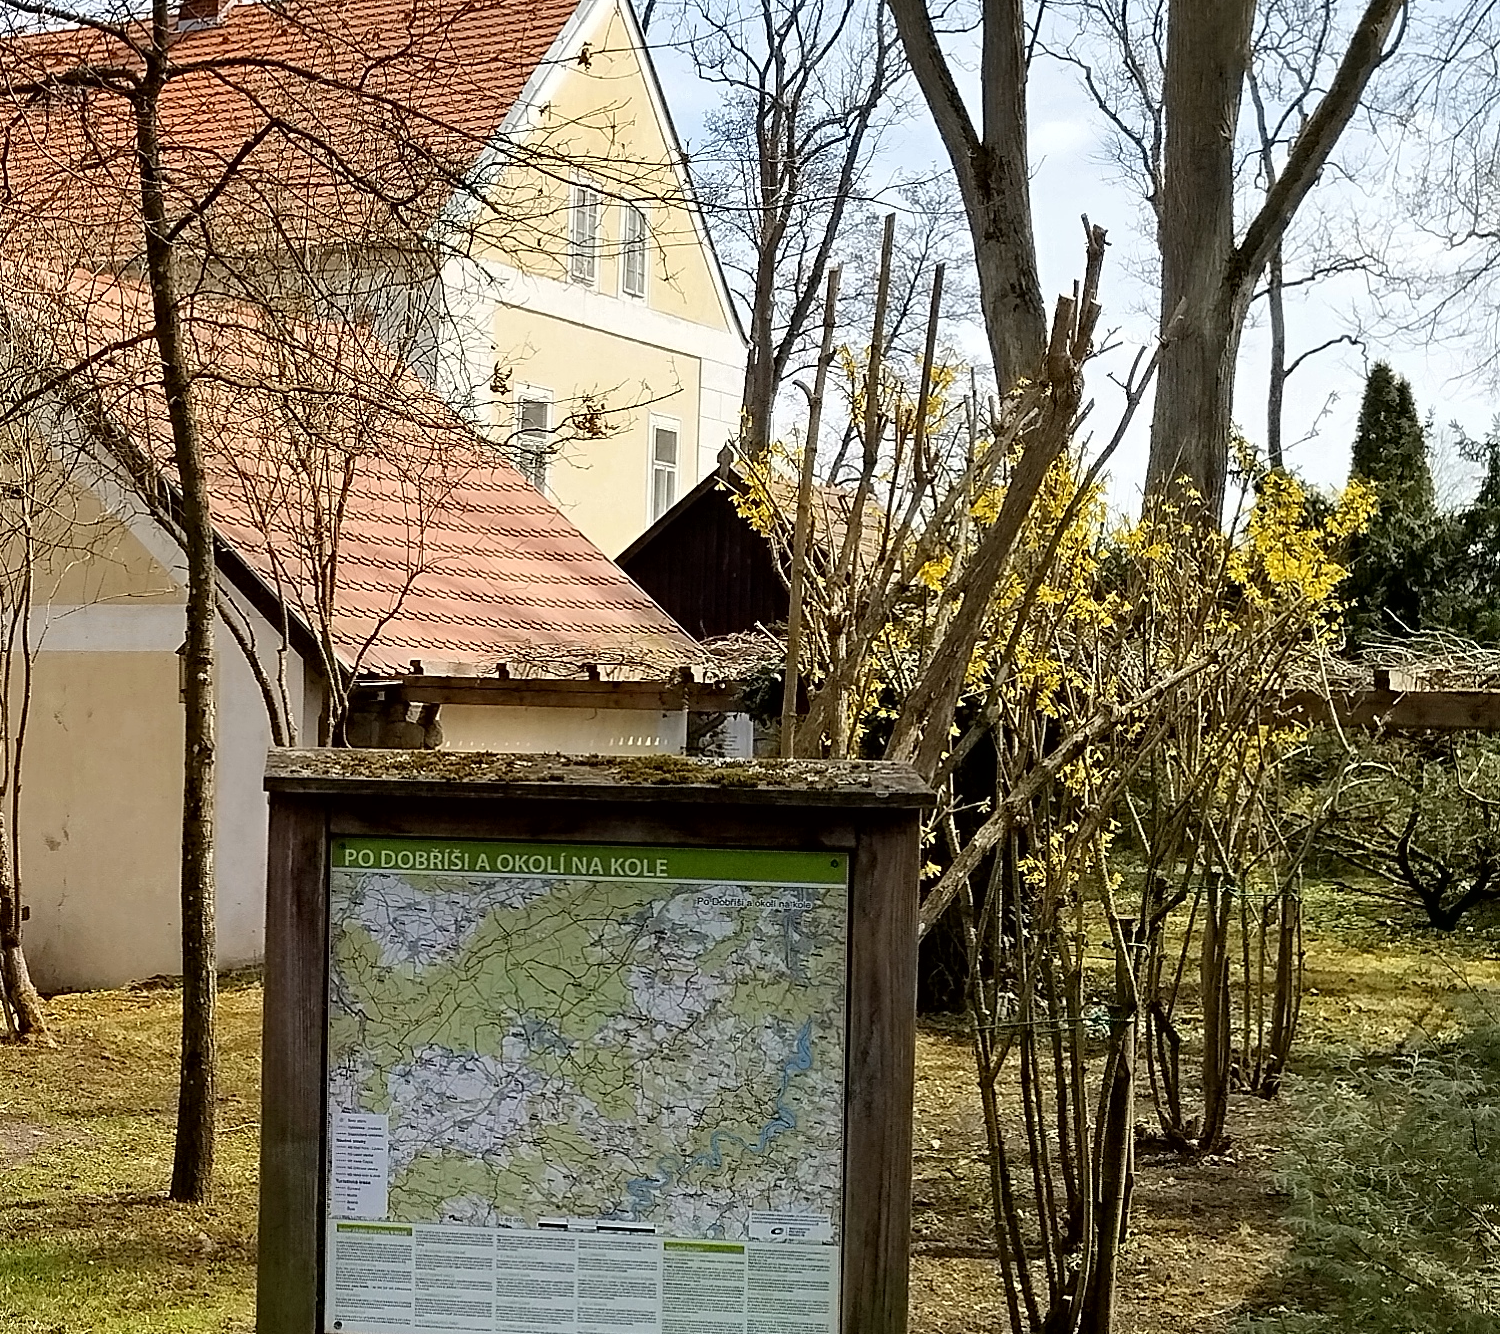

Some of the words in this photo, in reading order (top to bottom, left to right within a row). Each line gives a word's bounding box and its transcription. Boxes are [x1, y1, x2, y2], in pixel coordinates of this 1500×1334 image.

[344, 849, 374, 867] PO
[381, 848, 469, 871] DOBŘÍŠI
[475, 854, 491, 871] A
[497, 853, 566, 874] OKOLÍ
[572, 857, 604, 875] NA
[611, 858, 668, 877] KOLE
[697, 897, 710, 906] Po
[754, 899, 776, 908] okolí
[791, 900, 812, 909] kole
